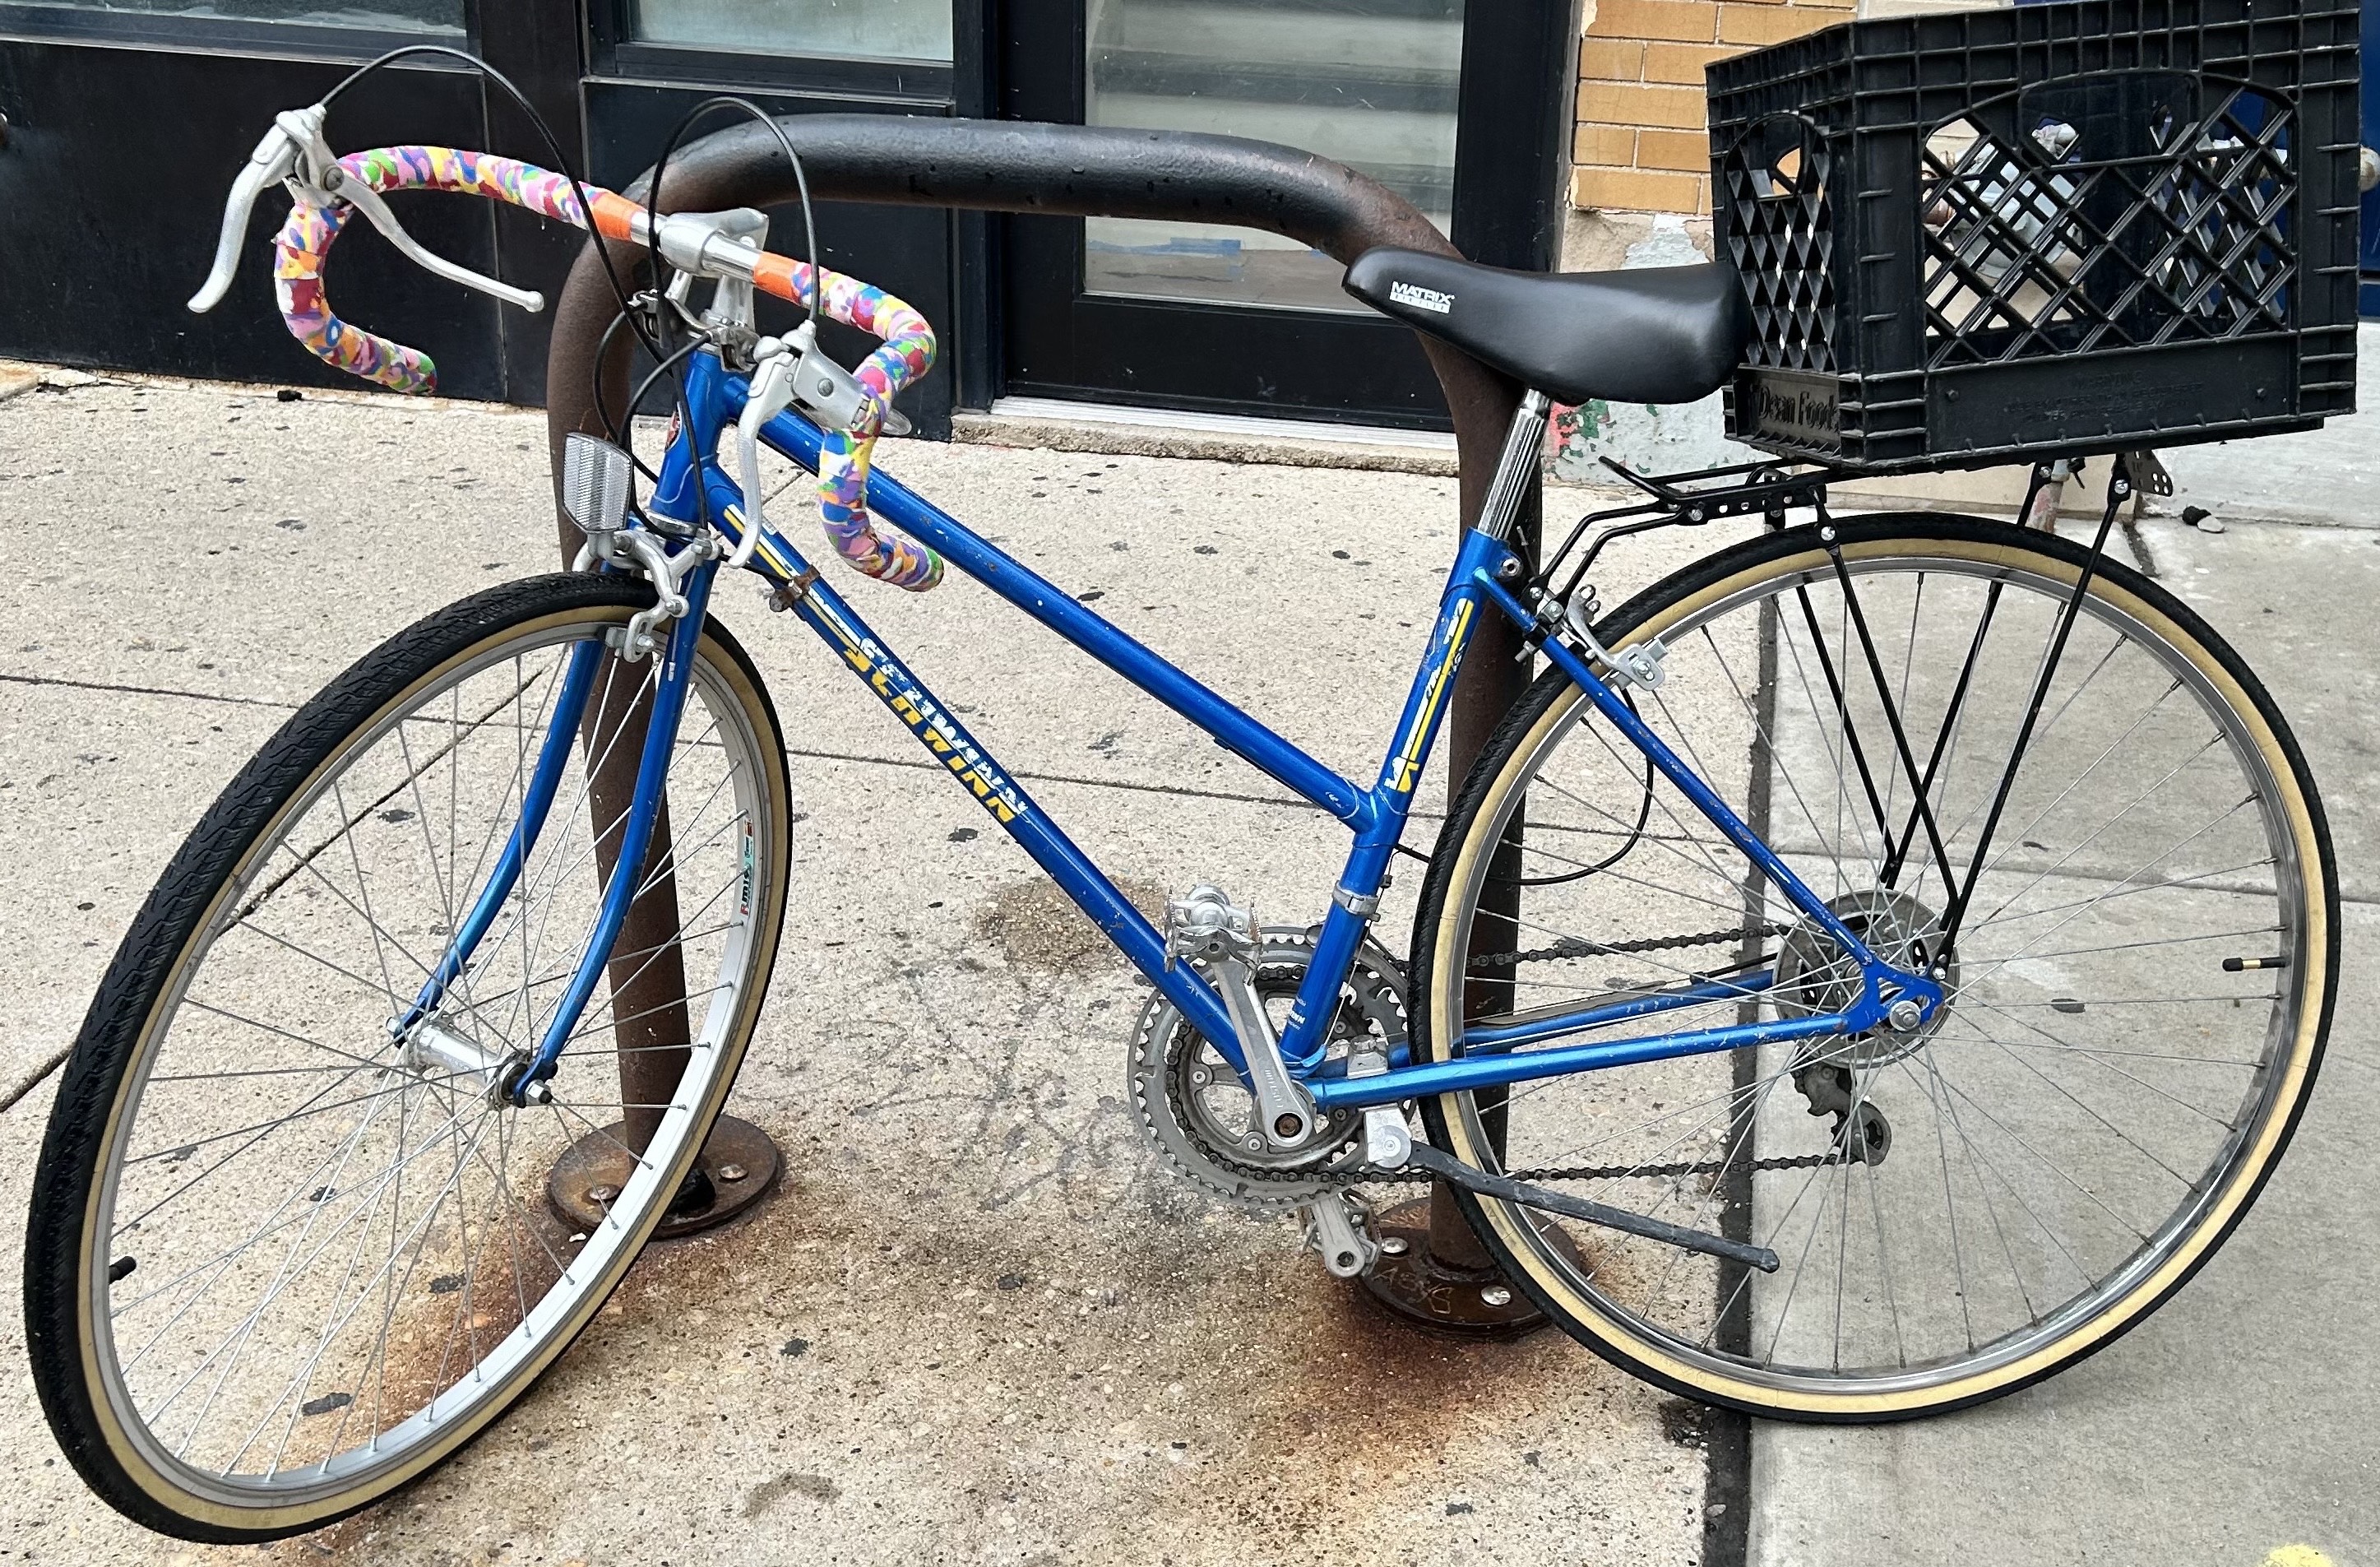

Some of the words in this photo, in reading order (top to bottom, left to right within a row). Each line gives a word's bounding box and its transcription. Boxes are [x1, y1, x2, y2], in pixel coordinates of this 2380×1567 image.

[1391, 280, 1452, 305] MATRIX
[1758, 386, 1796, 425] Dean
[844, 637, 1029, 823] SCHWINN
